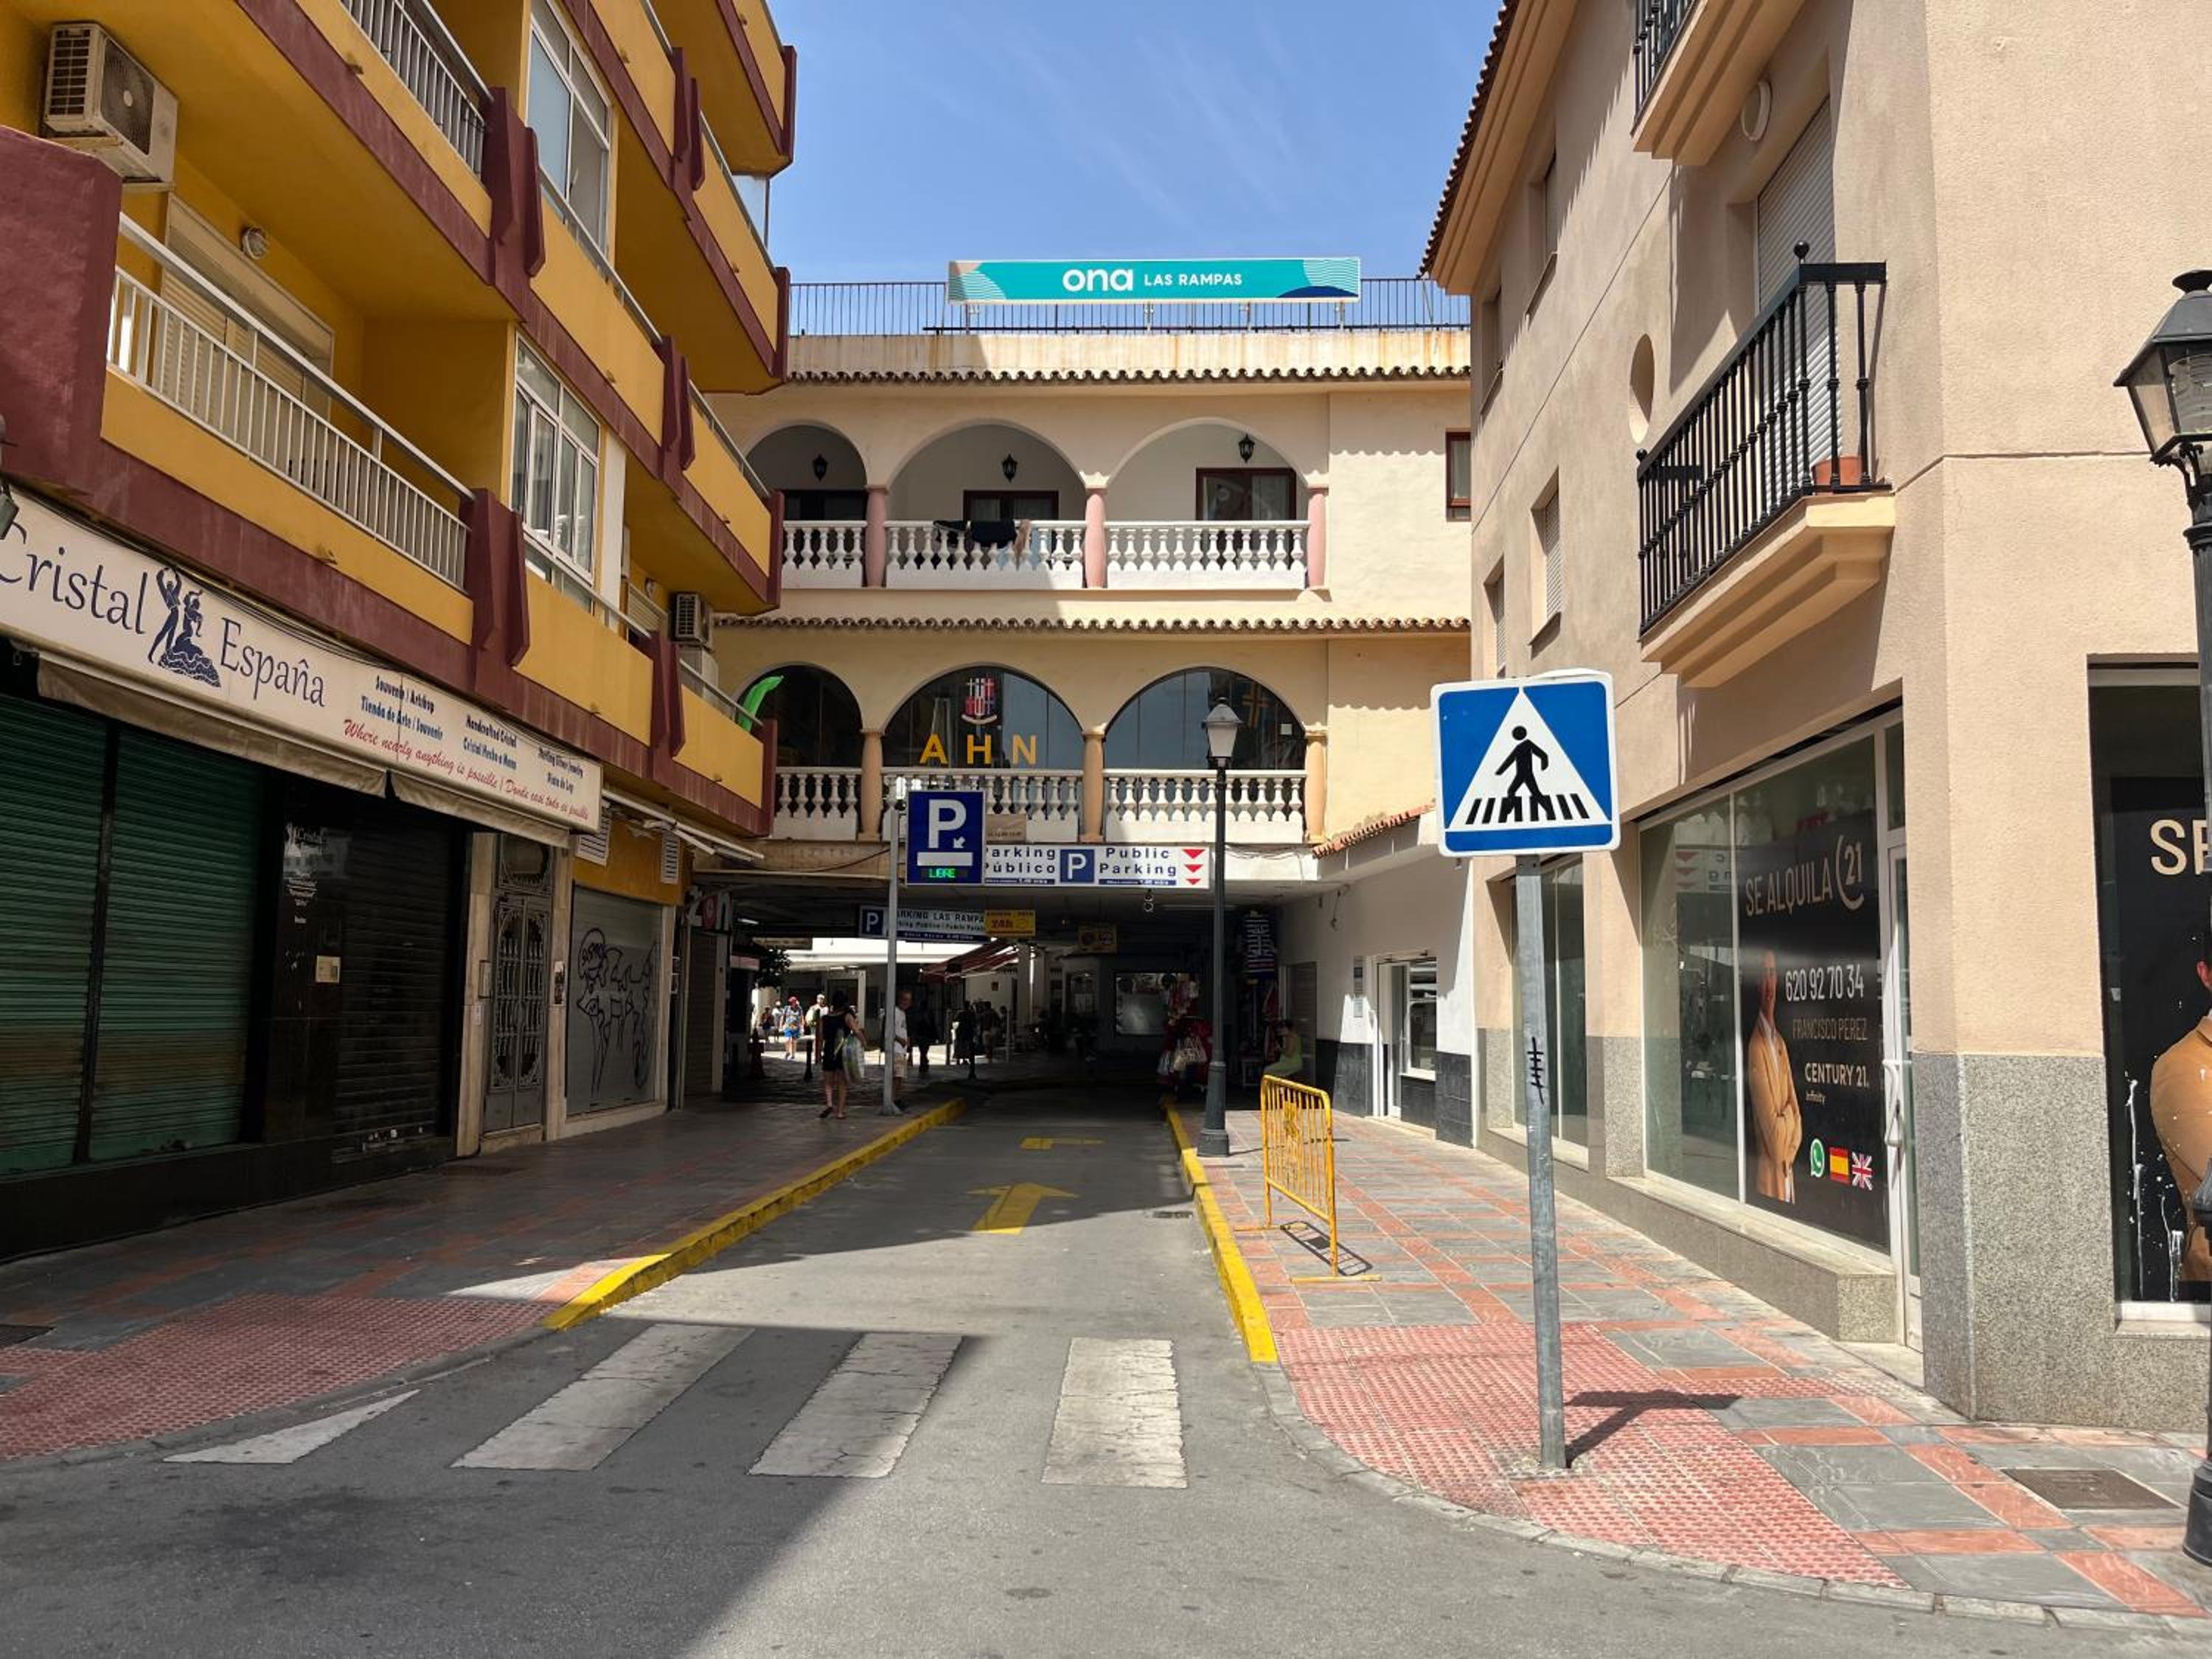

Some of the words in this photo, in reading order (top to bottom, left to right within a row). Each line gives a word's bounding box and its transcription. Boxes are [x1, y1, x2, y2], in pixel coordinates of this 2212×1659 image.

[1062, 268, 1133, 292] ona
[1144, 274, 1173, 286] LAS
[1179, 273, 1243, 285] RAMPAS
[220, 616, 325, 707] España
[361, 695, 386, 719] Tienda
[387, 706, 394, 723] de
[396, 710, 411, 729] Arte
[344, 719, 378, 745] Where
[382, 739, 412, 760] nearly
[415, 748, 454, 774] anything
[928, 799, 967, 849] P
[929, 868, 956, 878] LIBRE
[986, 846, 1055, 860] arking
[1067, 852, 1087, 880] P
[1106, 847, 1169, 859] Public
[986, 861, 1055, 874] úblico
[1099, 863, 1177, 877] Parking
[1745, 875, 1763, 917] SE
[1767, 857, 1834, 916] ALQUILA
[866, 911, 879, 933] P
[897, 909, 928, 919] ARKING
[933, 911, 950, 921] LAS
[955, 913, 984, 922] RAMPA
[1785, 969, 1807, 1001] 620
[1809, 967, 1825, 1001] 92
[1826, 965, 1843, 999] 70
[1846, 964, 1865, 998] 34
[1792, 1018, 1837, 1039] FRANCISCO
[1805, 1062, 1854, 1086] CENTURY
